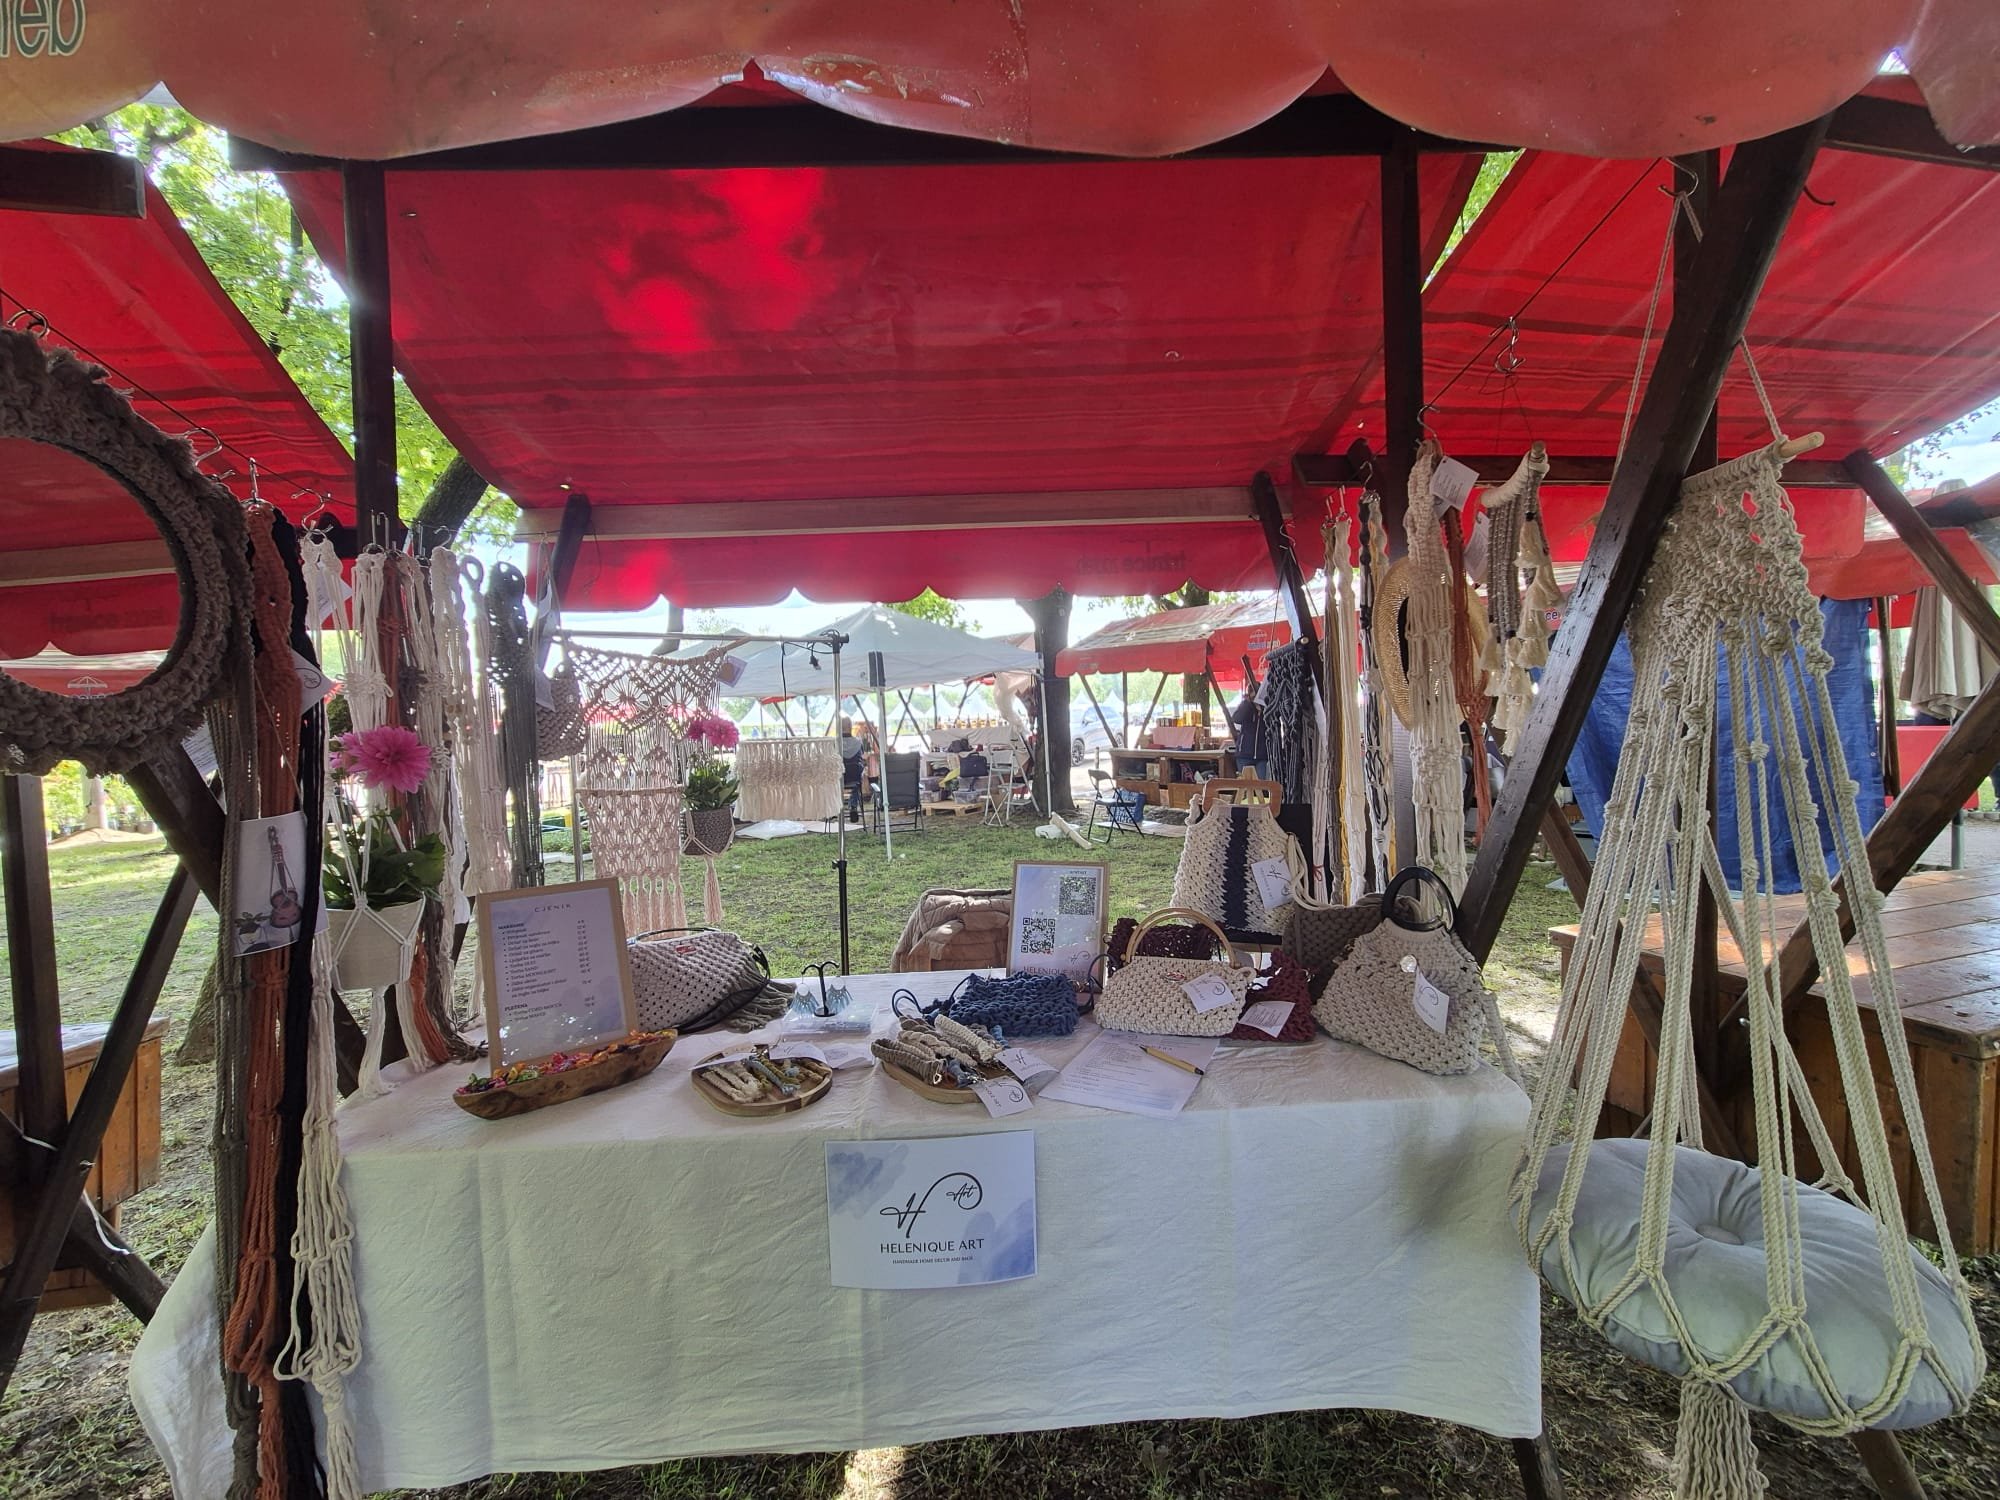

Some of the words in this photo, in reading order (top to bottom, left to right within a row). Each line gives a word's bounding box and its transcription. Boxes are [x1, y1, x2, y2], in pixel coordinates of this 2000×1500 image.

[945, 1182, 978, 1202] Art
[880, 1240, 955, 1254] HELENIQUE
[958, 1238, 985, 1250] ART
